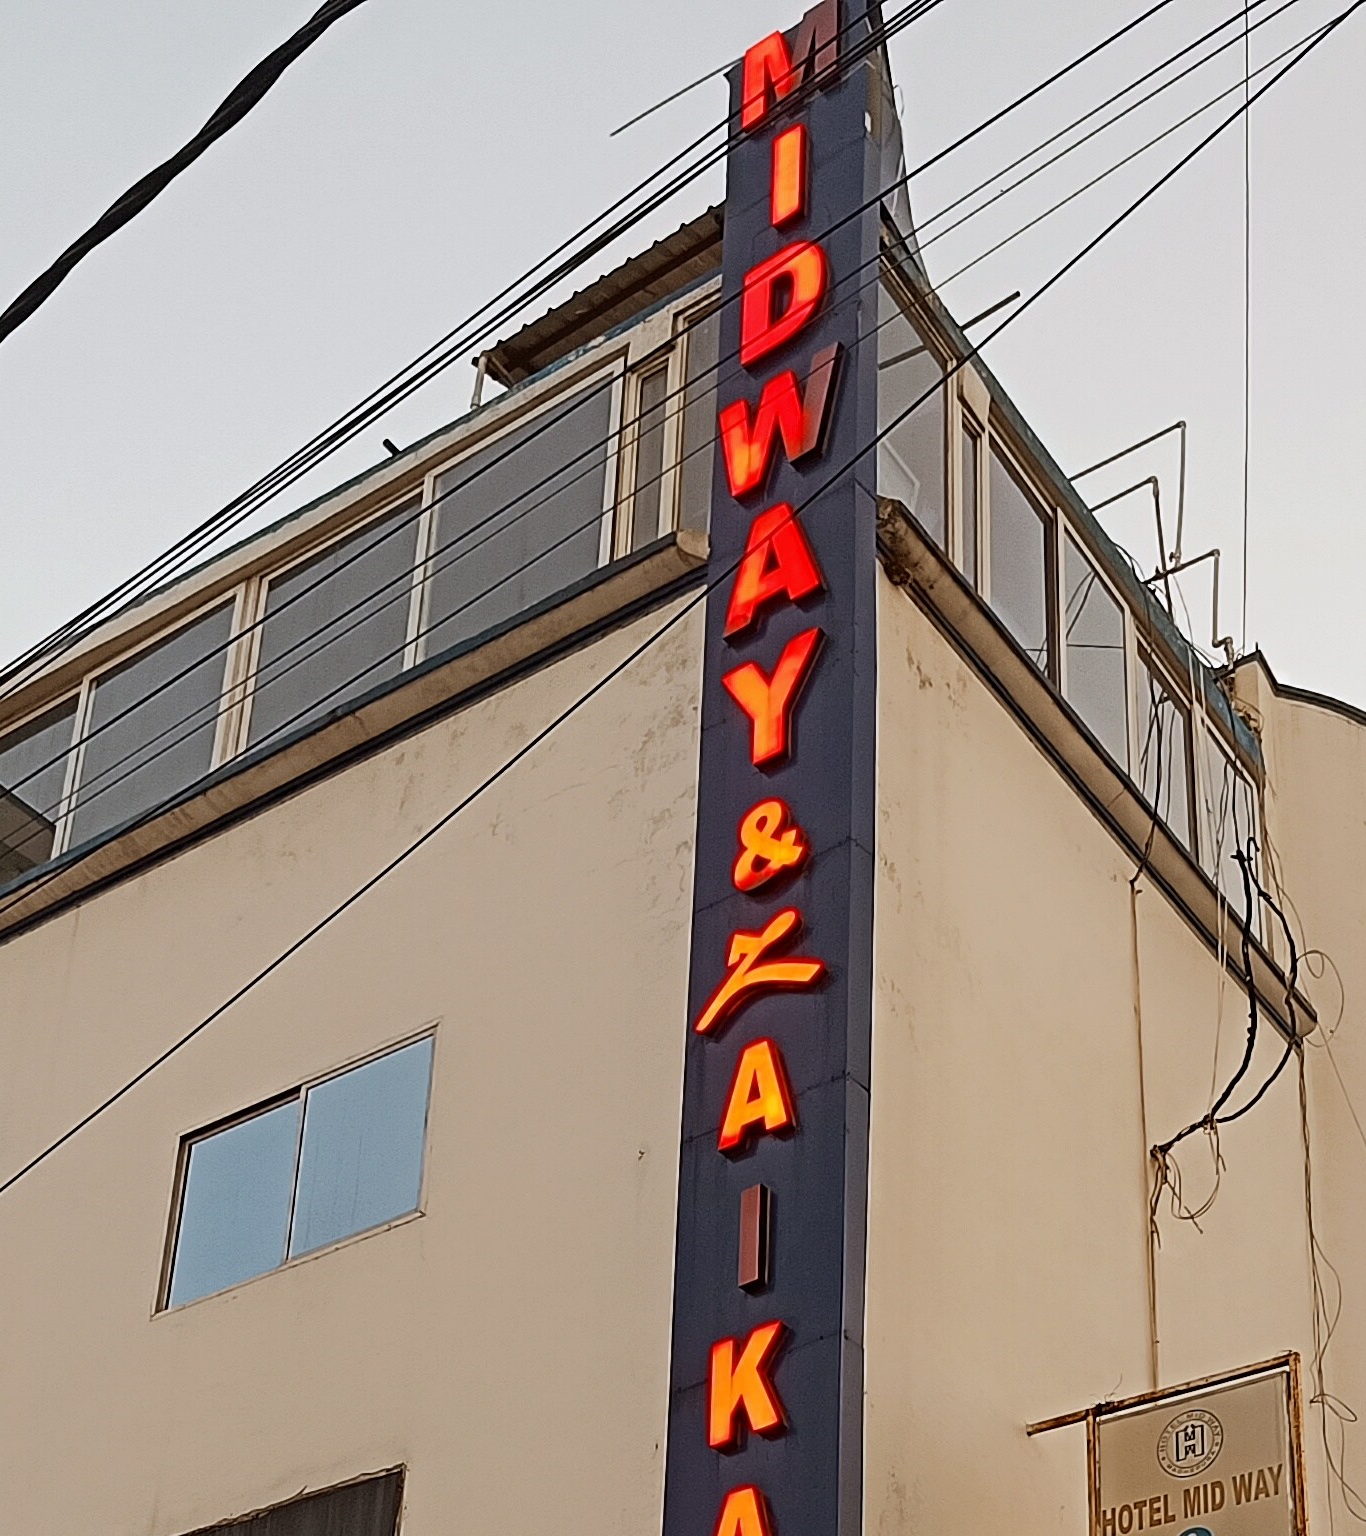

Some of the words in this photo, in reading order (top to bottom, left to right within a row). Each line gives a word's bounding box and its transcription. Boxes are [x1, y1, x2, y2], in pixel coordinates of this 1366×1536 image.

[719, 0, 844, 767] MIDWAY
[732, 797, 809, 893] &
[1183, 1480, 1225, 1519] MID
[1231, 1463, 1284, 1506] WAY
